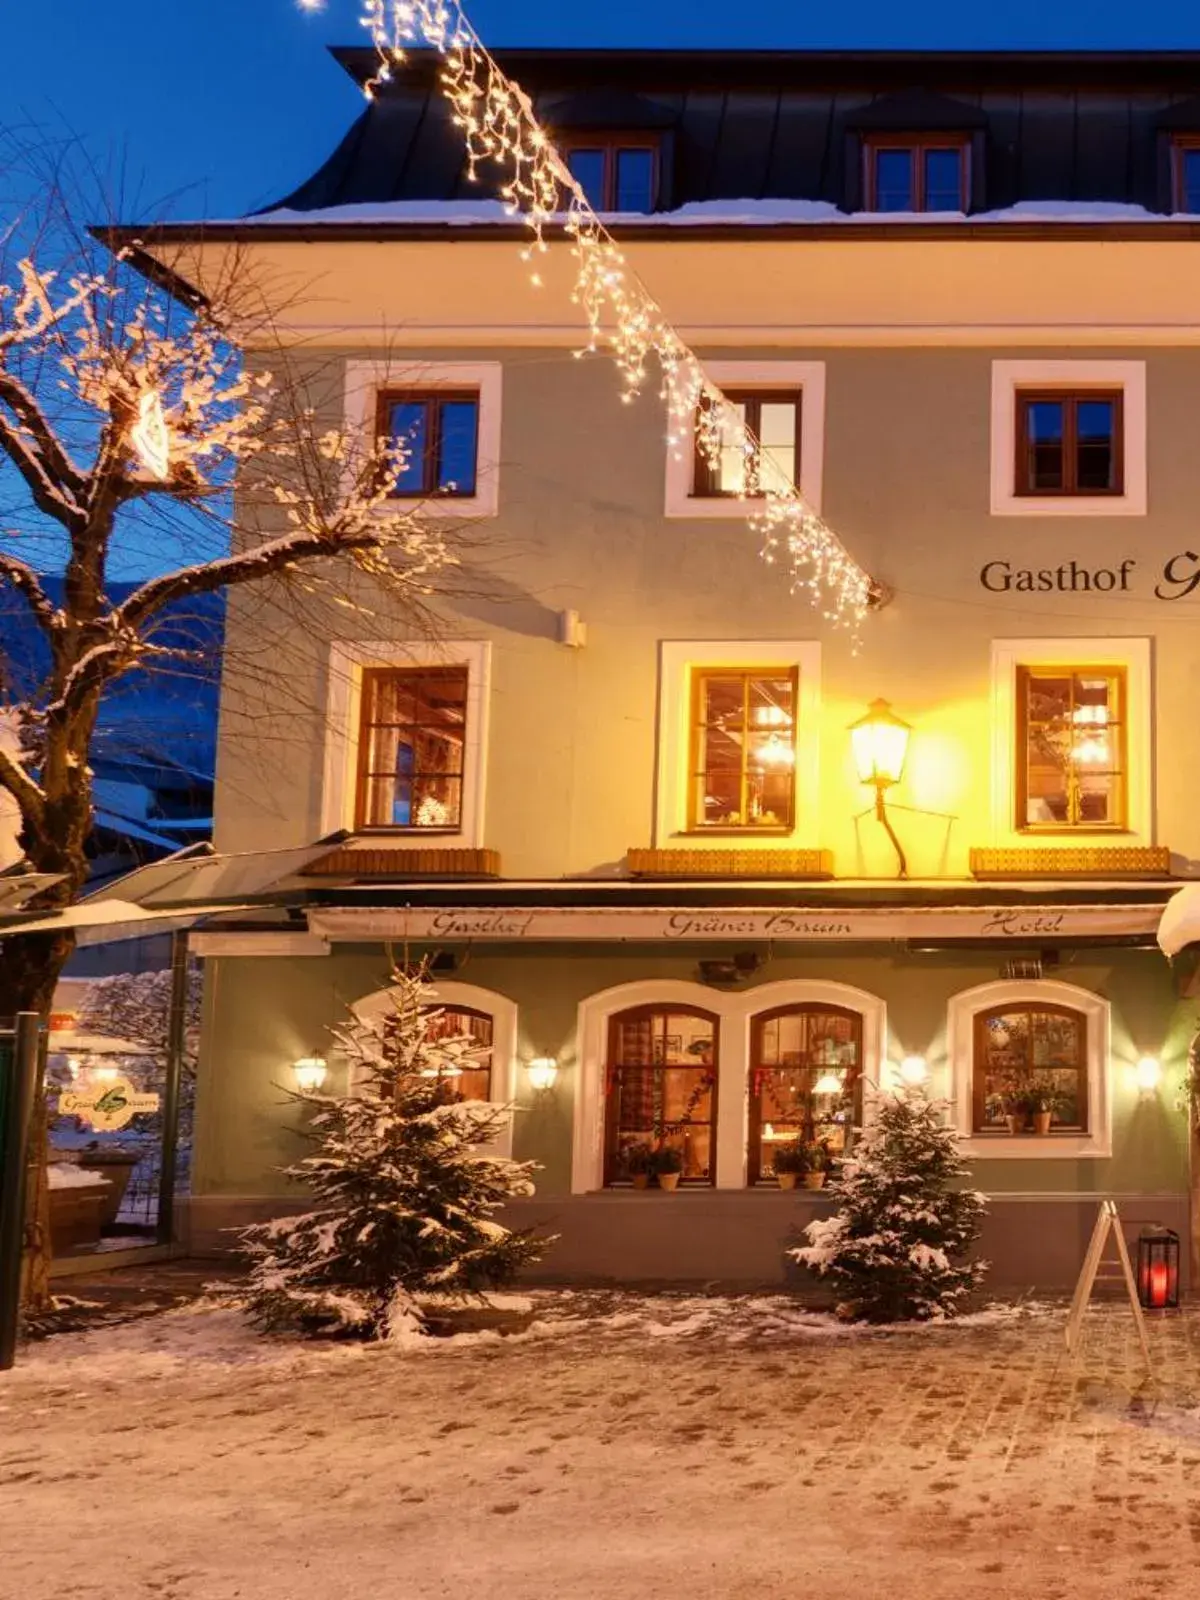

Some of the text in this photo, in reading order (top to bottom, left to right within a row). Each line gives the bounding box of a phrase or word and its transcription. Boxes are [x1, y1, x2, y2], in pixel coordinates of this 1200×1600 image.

[980, 560, 1135, 592] Gasthof
[427, 910, 1063, 937] Gasthof Grüner Baum Hotel
